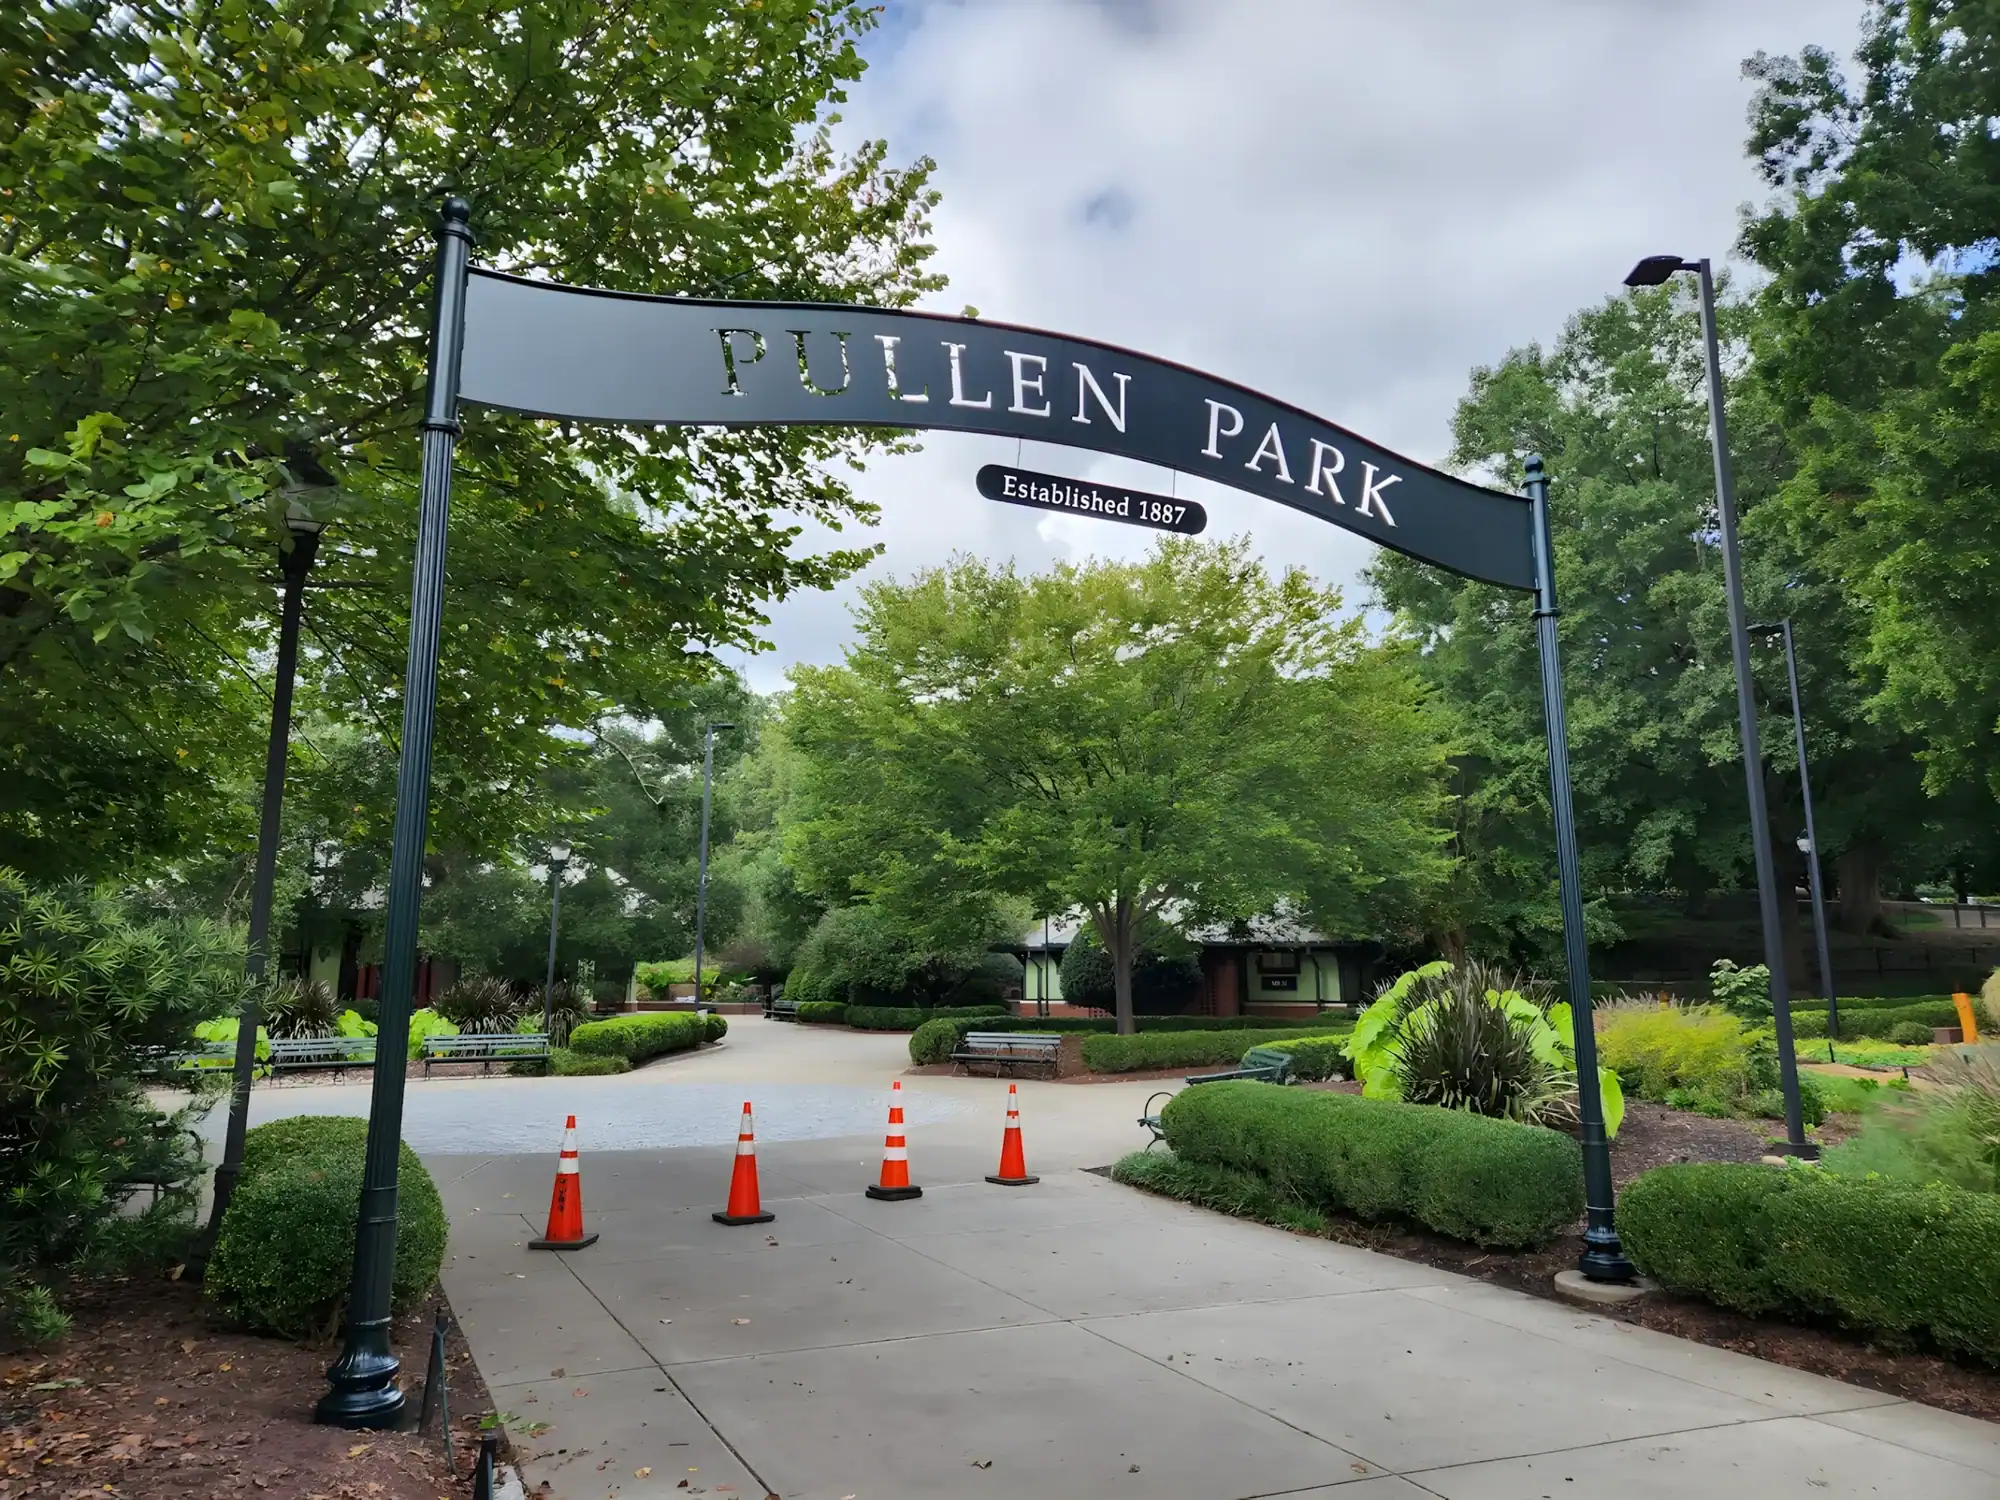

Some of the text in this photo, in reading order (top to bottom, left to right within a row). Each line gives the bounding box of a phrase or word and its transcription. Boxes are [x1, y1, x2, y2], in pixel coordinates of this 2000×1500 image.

[709, 328, 1403, 528] PULLEN PARK
[1002, 474, 1187, 525] Established 1887
